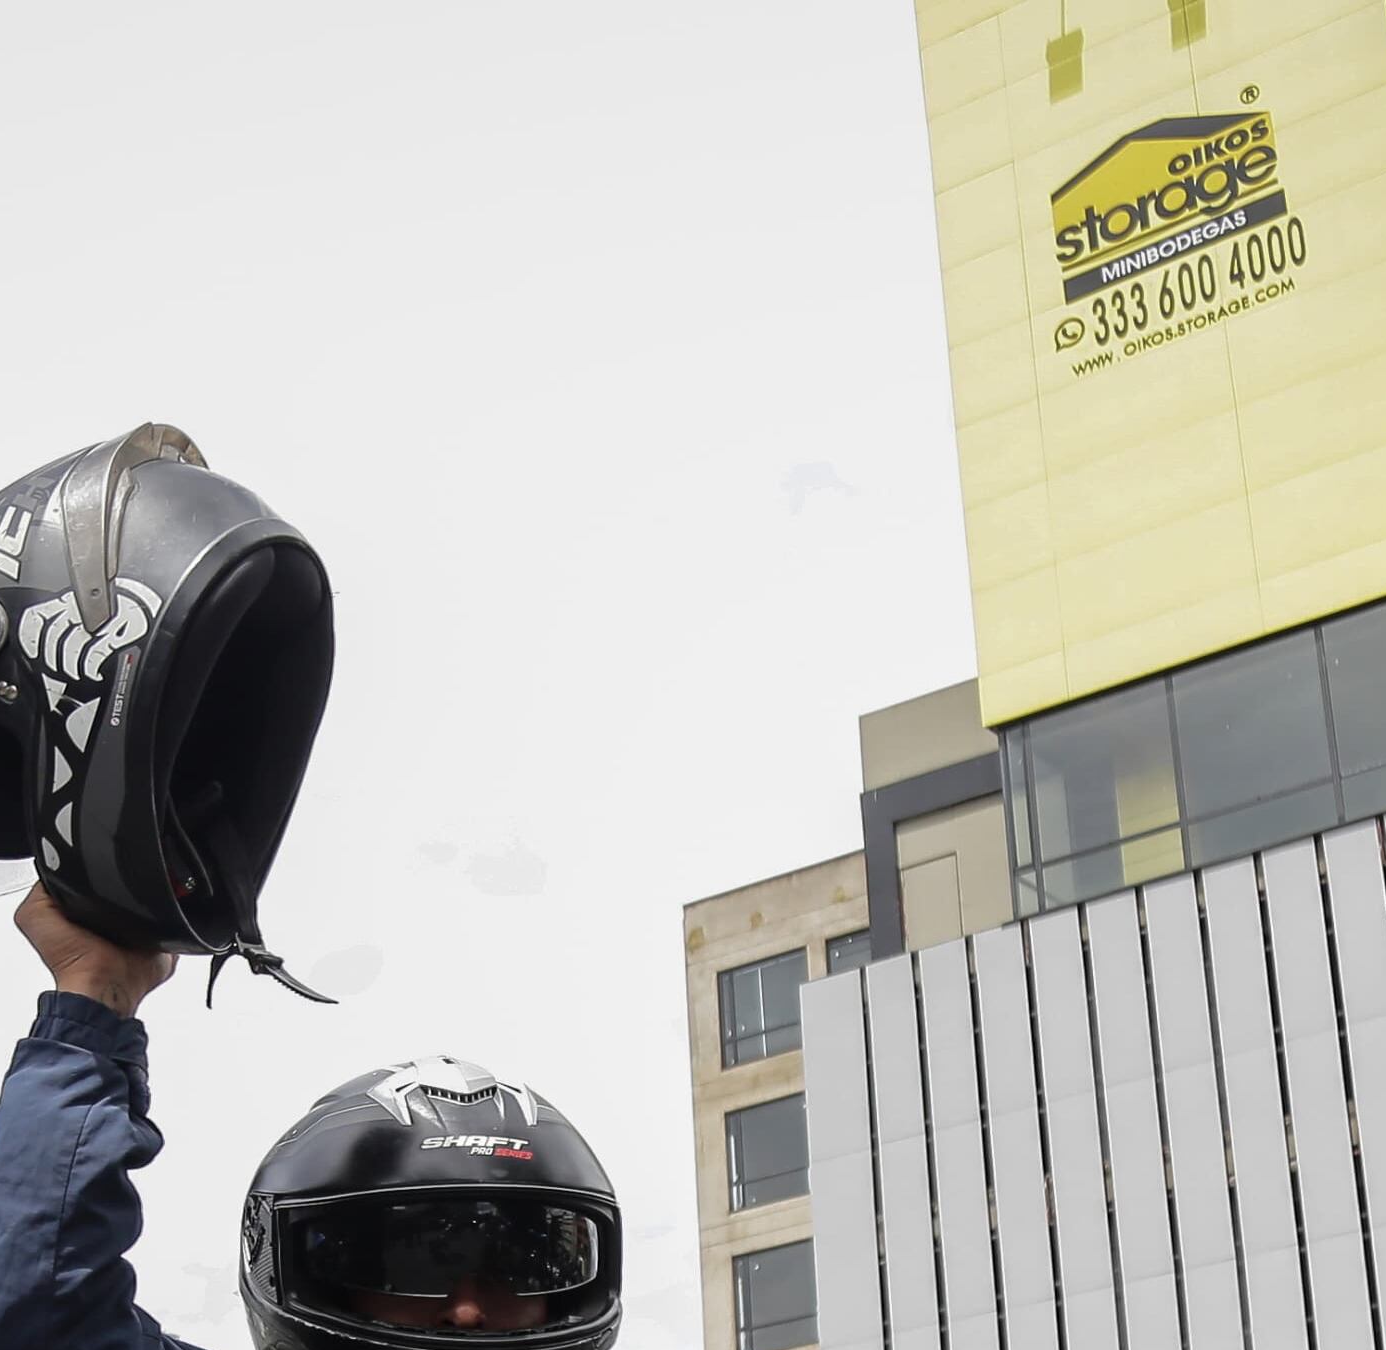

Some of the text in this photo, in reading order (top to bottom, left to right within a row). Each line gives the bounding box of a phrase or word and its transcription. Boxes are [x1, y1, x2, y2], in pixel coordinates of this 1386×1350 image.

[1167, 118, 1270, 176] OIKOS
[1056, 145, 1277, 264] storage
[1101, 209, 1248, 284] MINIBODEGAS
[1091, 215, 1307, 347] 333 600 4000
[421, 1135, 529, 1150] SHAFT
[470, 1147, 533, 1160] PRO SERIES
